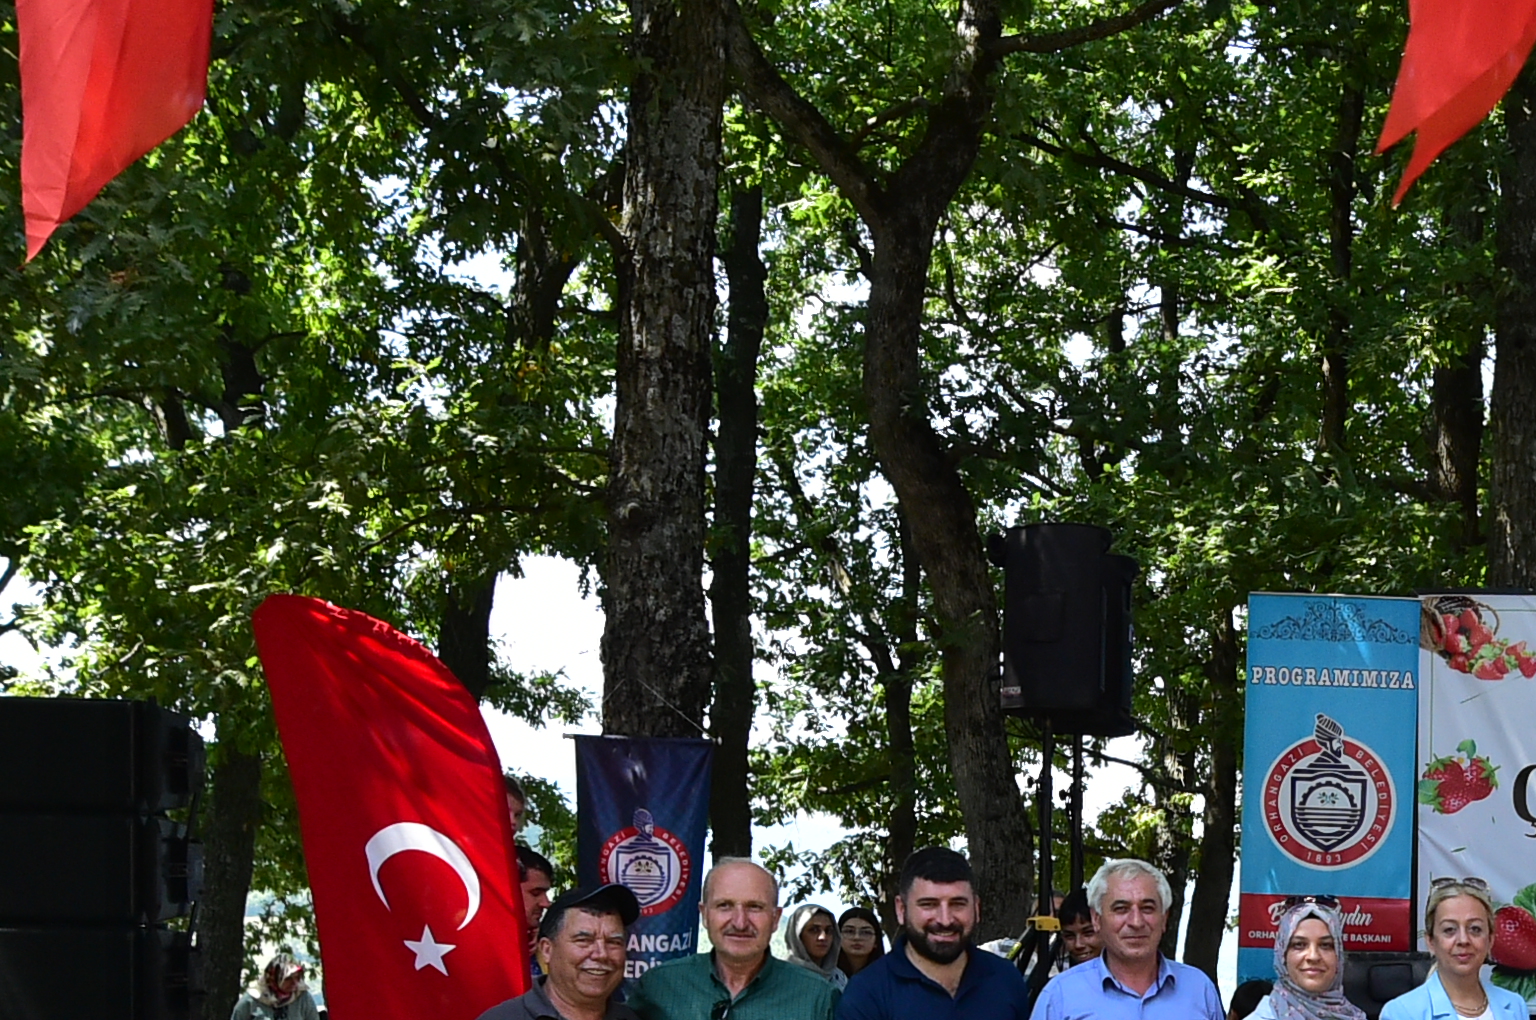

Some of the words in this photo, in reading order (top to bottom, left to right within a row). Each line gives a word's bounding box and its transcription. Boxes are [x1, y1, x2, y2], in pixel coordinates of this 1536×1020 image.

[1251, 666, 1415, 690] PROGRAMIMIZA
[1306, 851, 1341, 864] 1893
[1336, 899, 1373, 929] ydın
[1350, 932, 1392, 944] BAŞKANI
